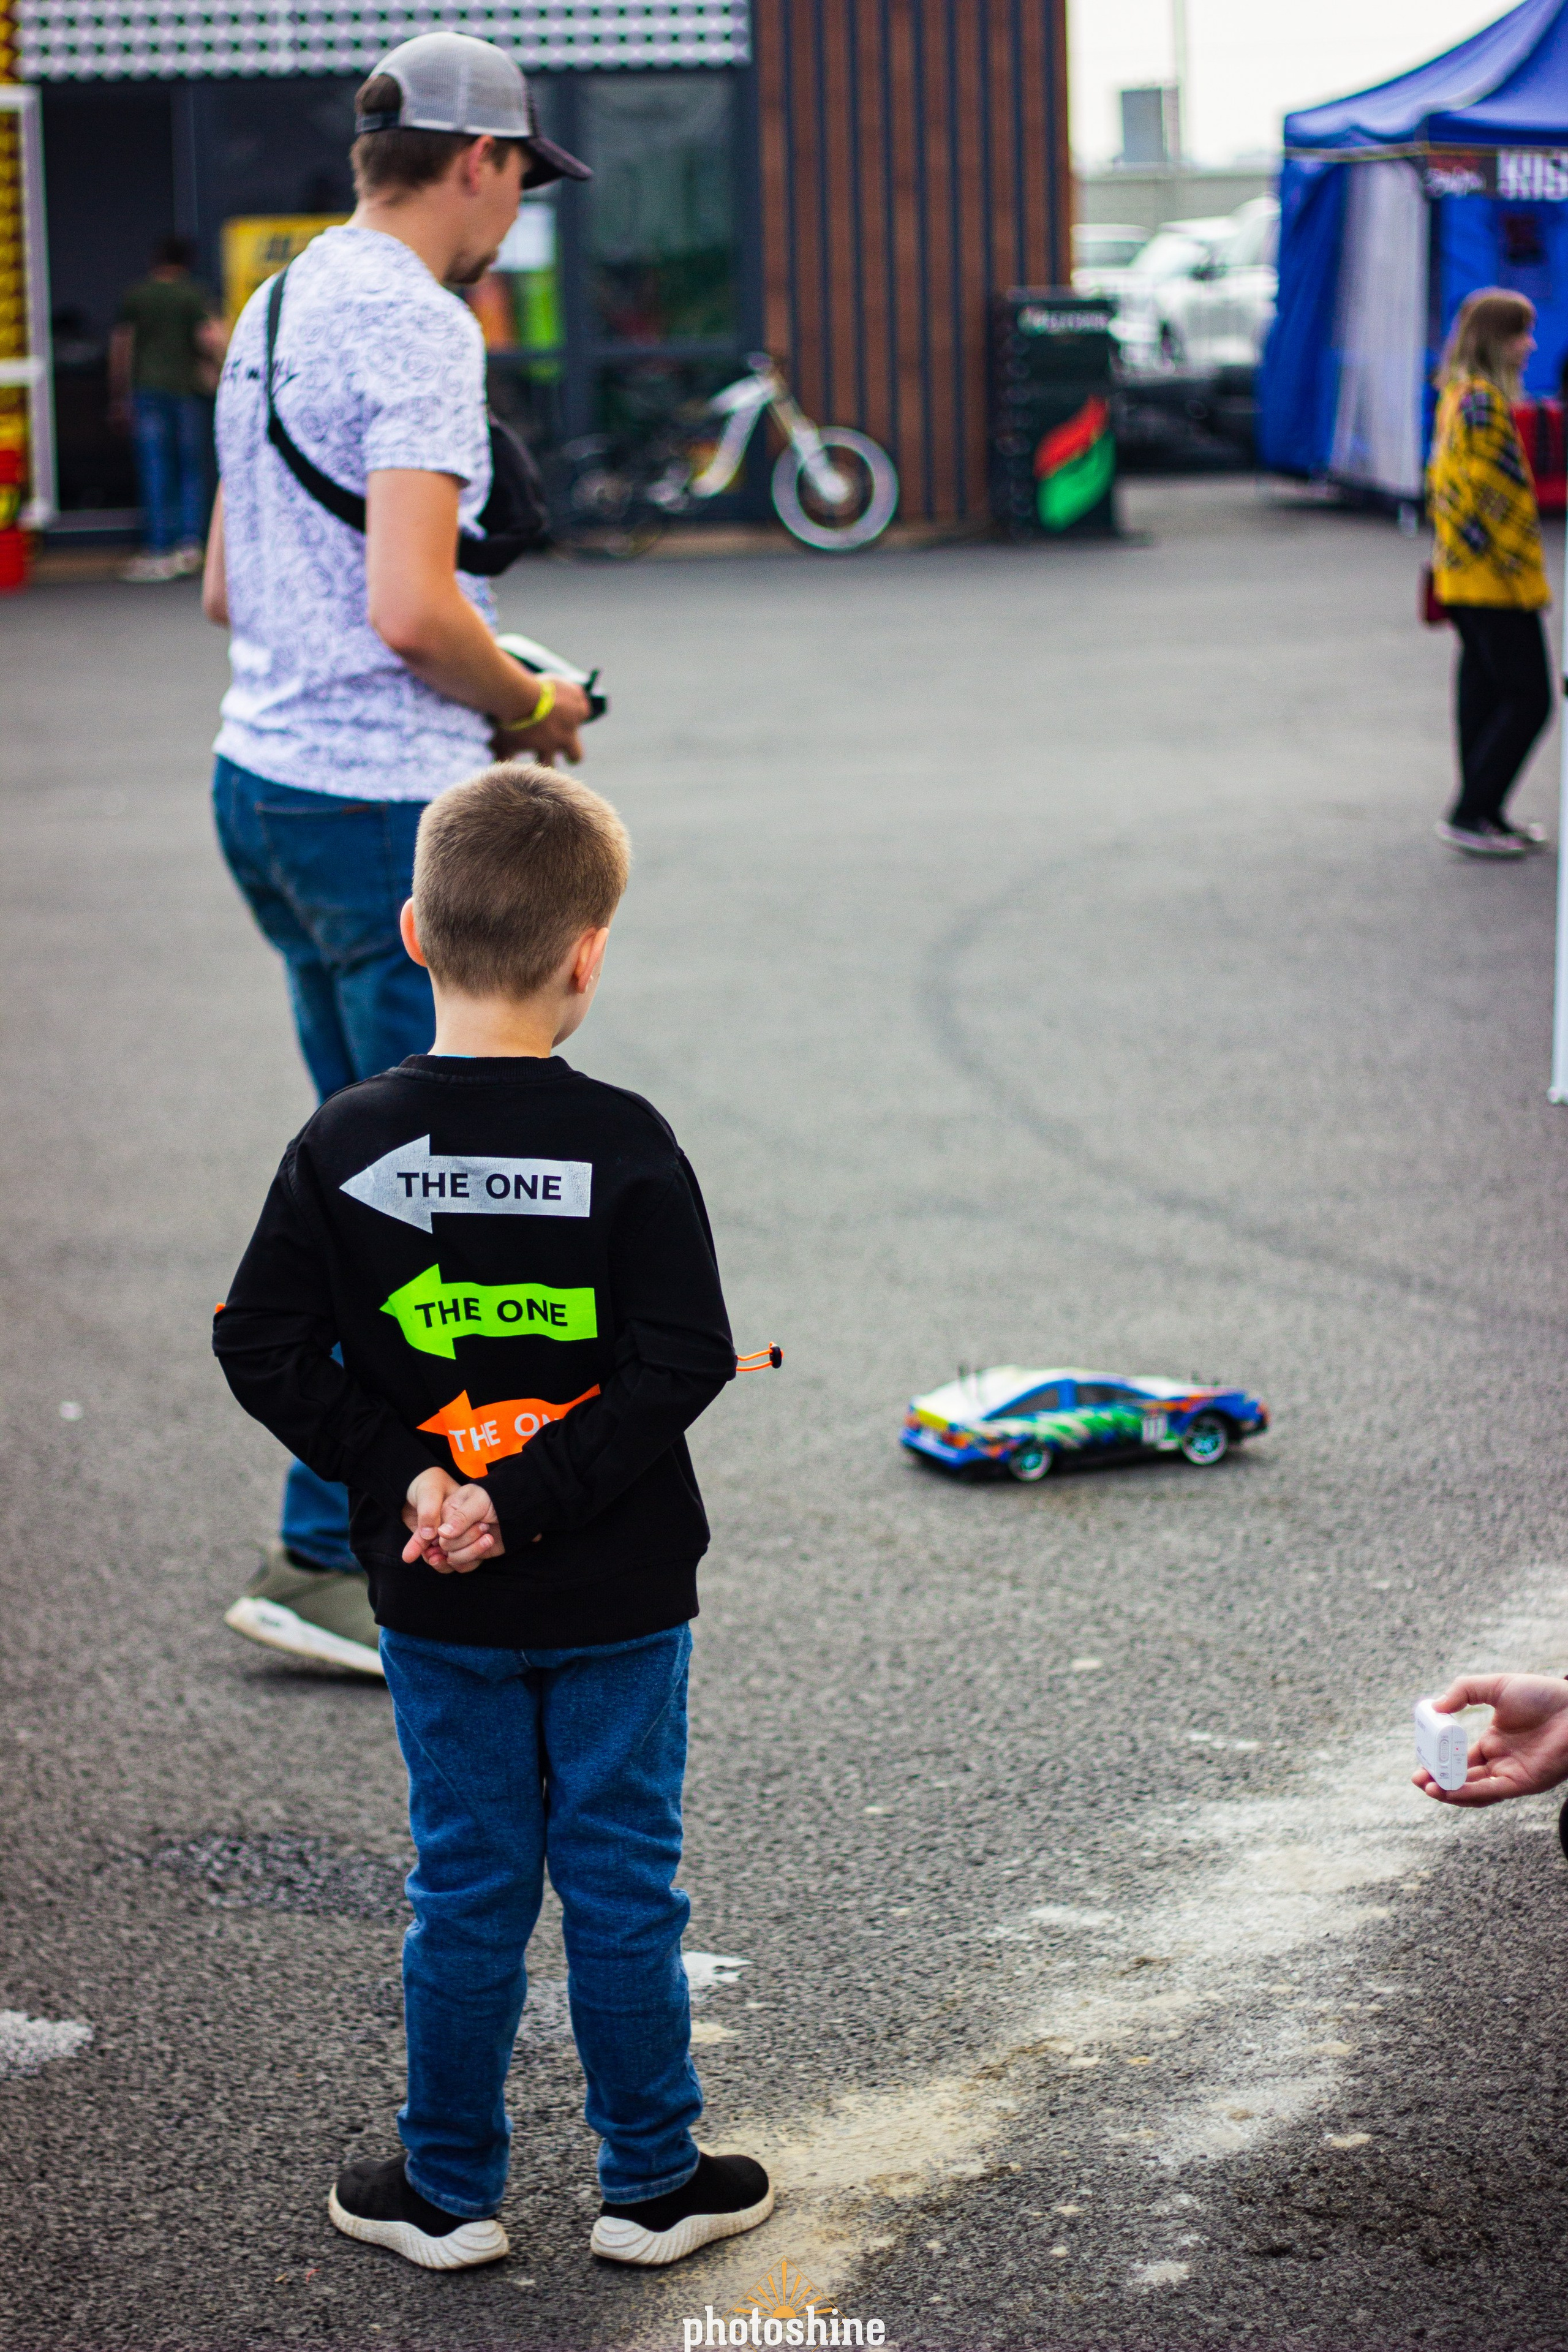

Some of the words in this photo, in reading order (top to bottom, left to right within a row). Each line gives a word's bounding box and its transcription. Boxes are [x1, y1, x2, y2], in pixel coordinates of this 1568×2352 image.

[397, 1172, 470, 1198] THE
[486, 1174, 562, 1201] ONE
[415, 1298, 481, 1328] THE
[497, 1299, 568, 1327] ONE
[448, 1420, 501, 1452] THE
